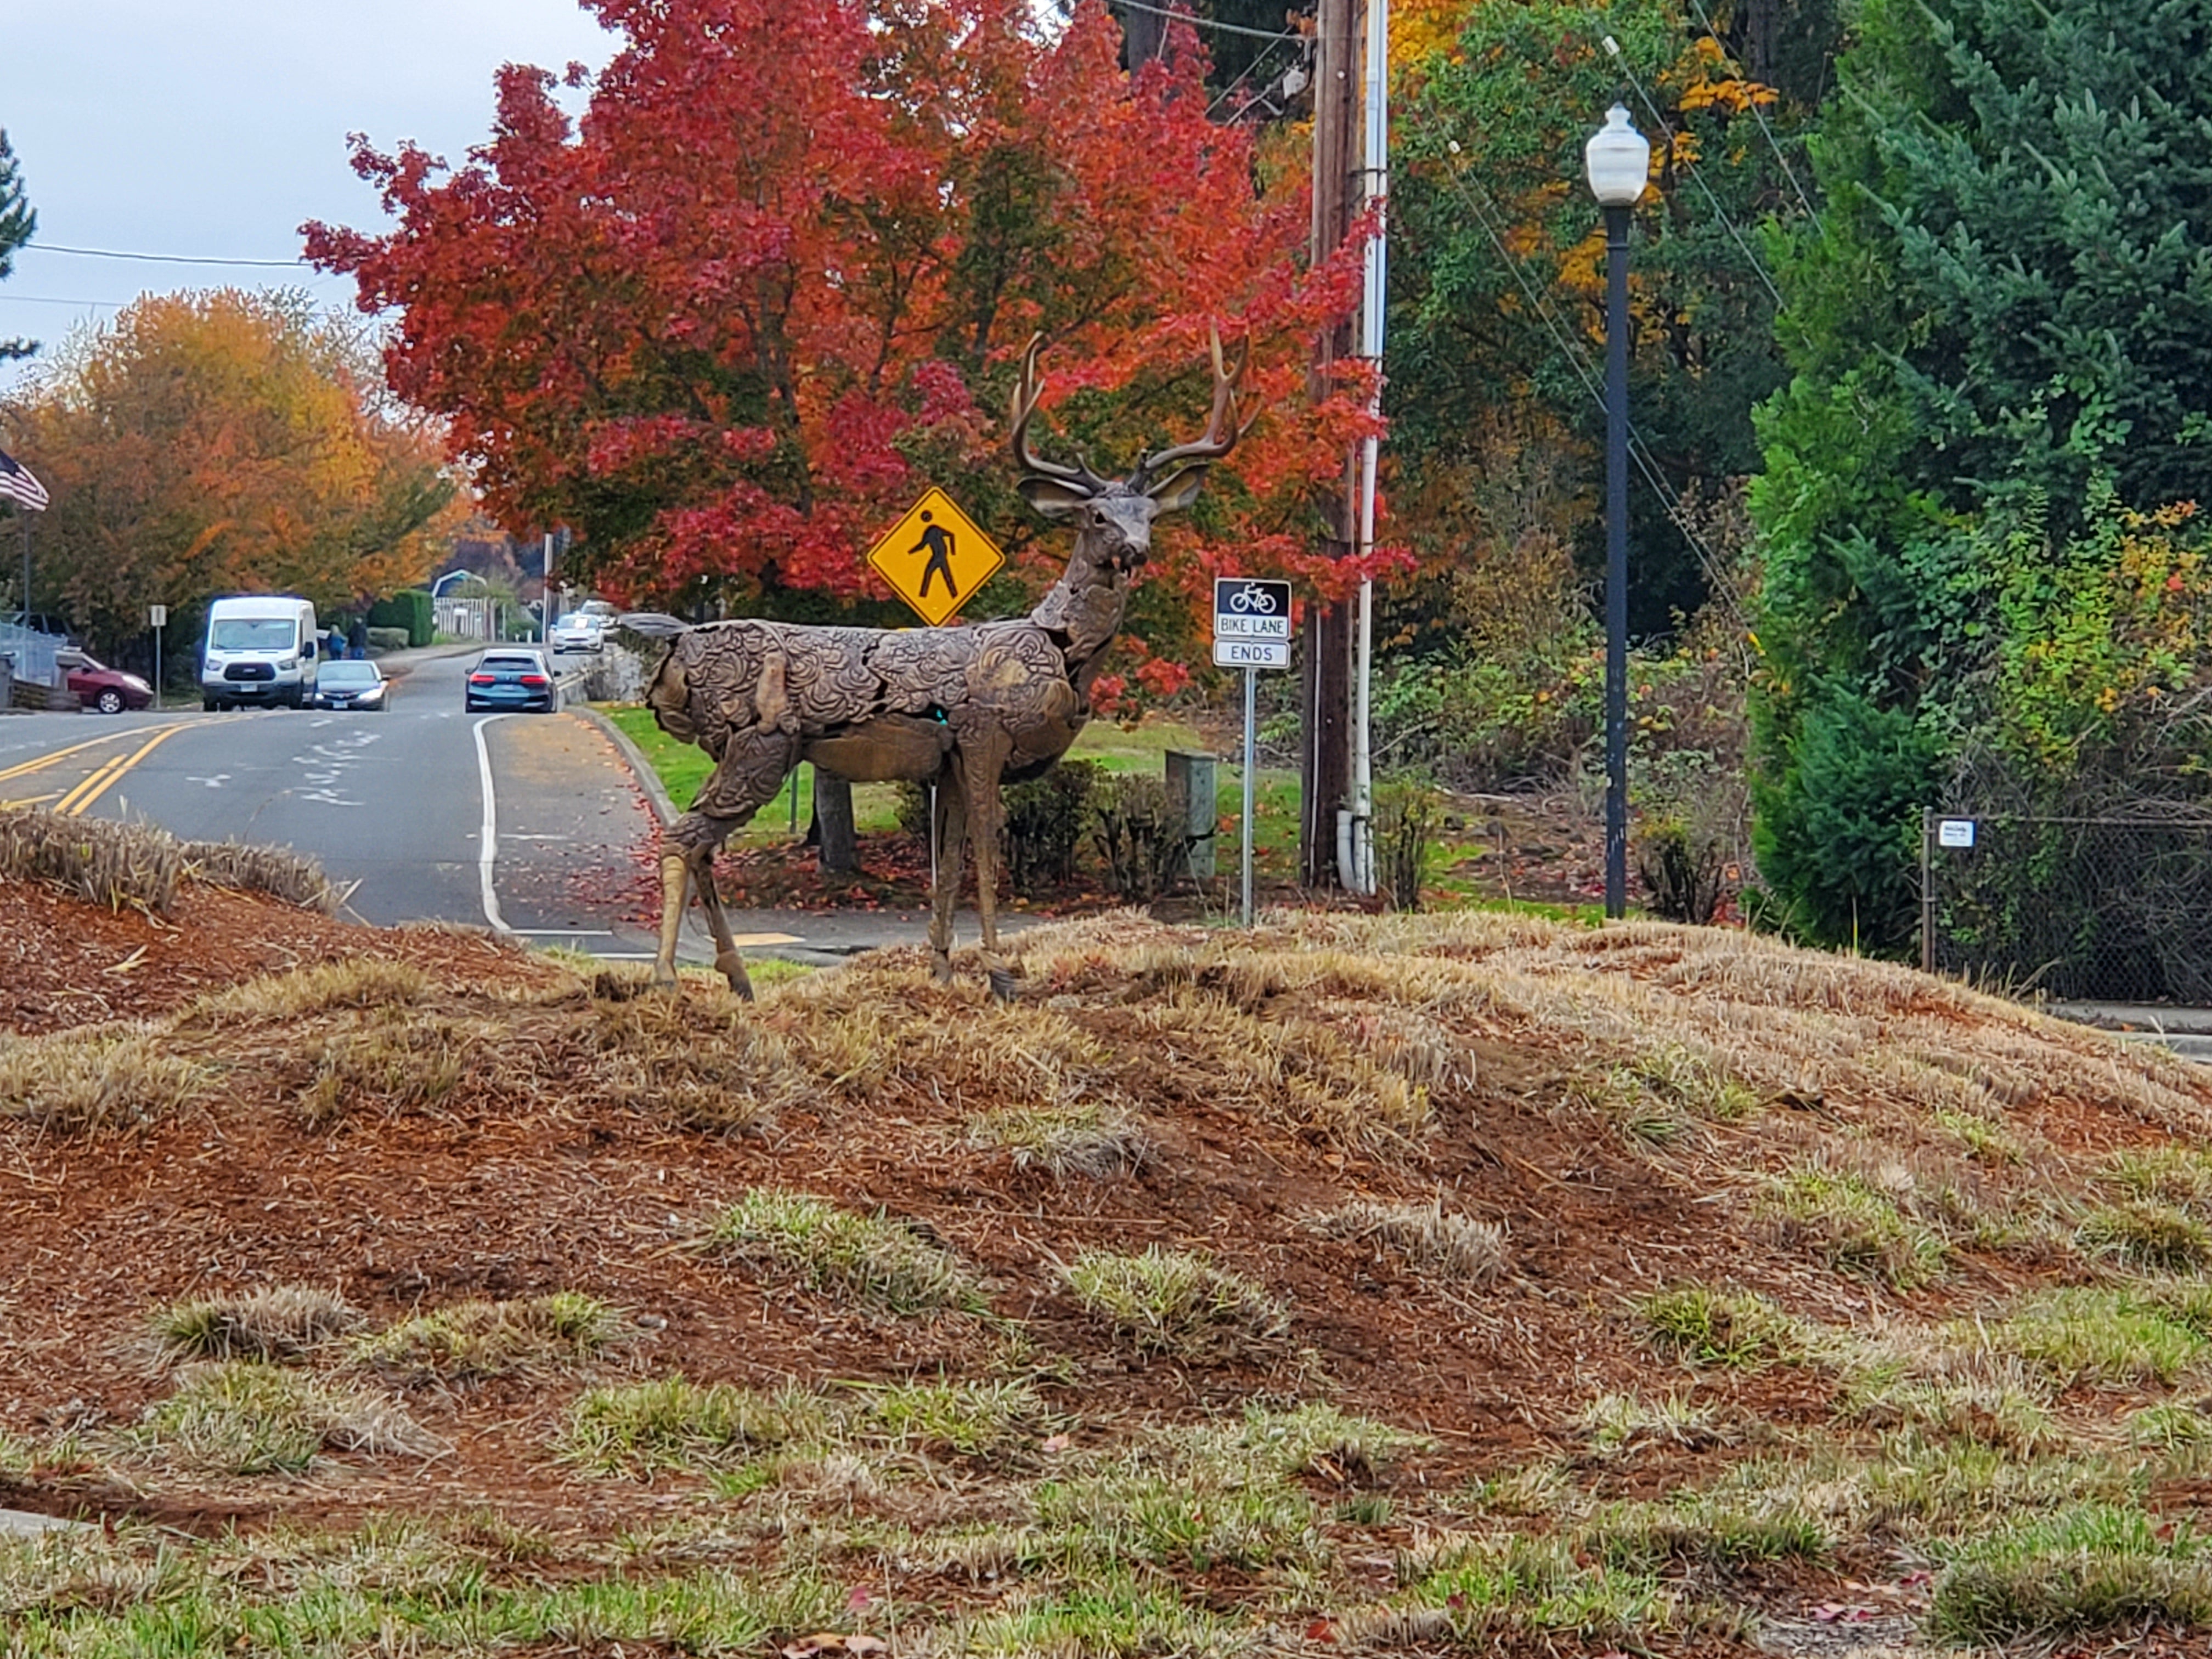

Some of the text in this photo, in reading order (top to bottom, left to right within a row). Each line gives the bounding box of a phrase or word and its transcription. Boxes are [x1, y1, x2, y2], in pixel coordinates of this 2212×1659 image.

[1221, 618, 1284, 634] BIKE LANE
[1231, 646, 1272, 661] ENDS
